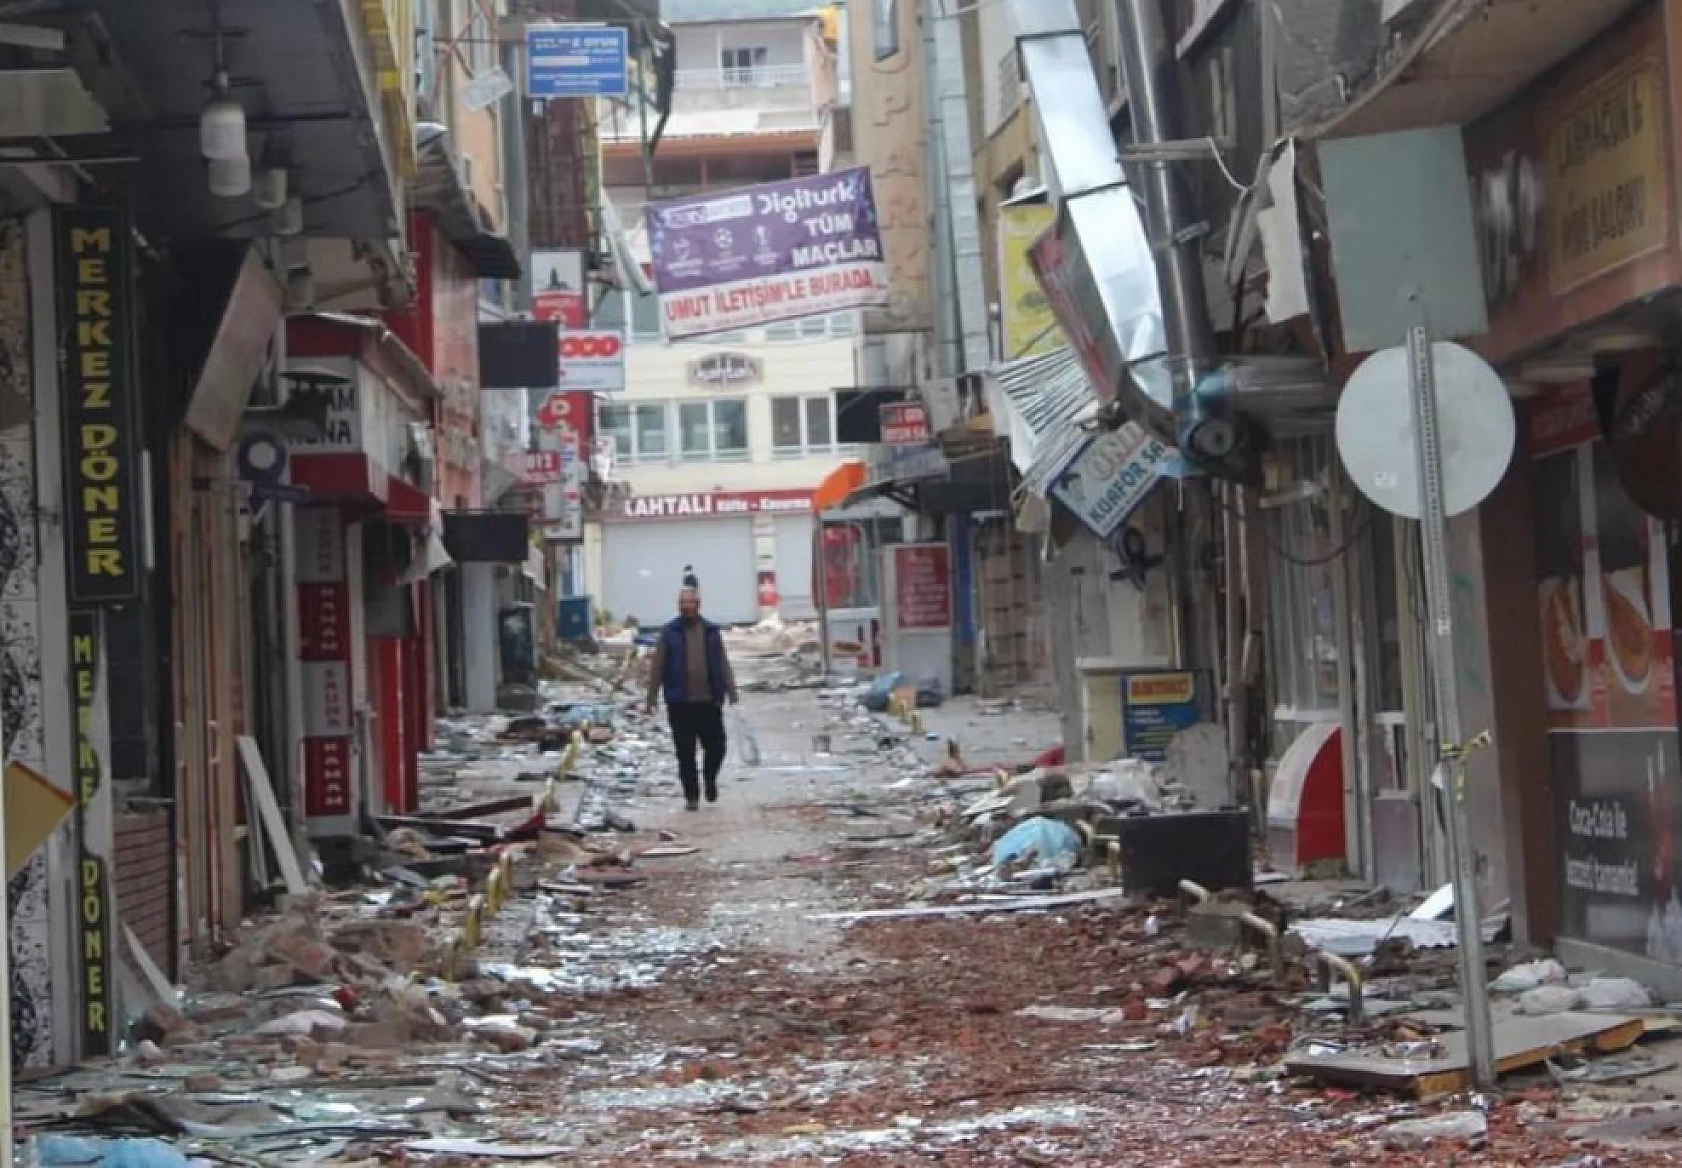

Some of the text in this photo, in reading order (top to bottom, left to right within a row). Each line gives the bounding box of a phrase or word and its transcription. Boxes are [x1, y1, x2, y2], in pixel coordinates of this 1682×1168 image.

[805, 213, 853, 236] TÜM
[791, 239, 879, 267] MAÇLAR
[666, 296, 711, 321] UMUT
[71, 227, 124, 576] MERKEZ DÖNER
[323, 742, 343, 806] HAMAM
